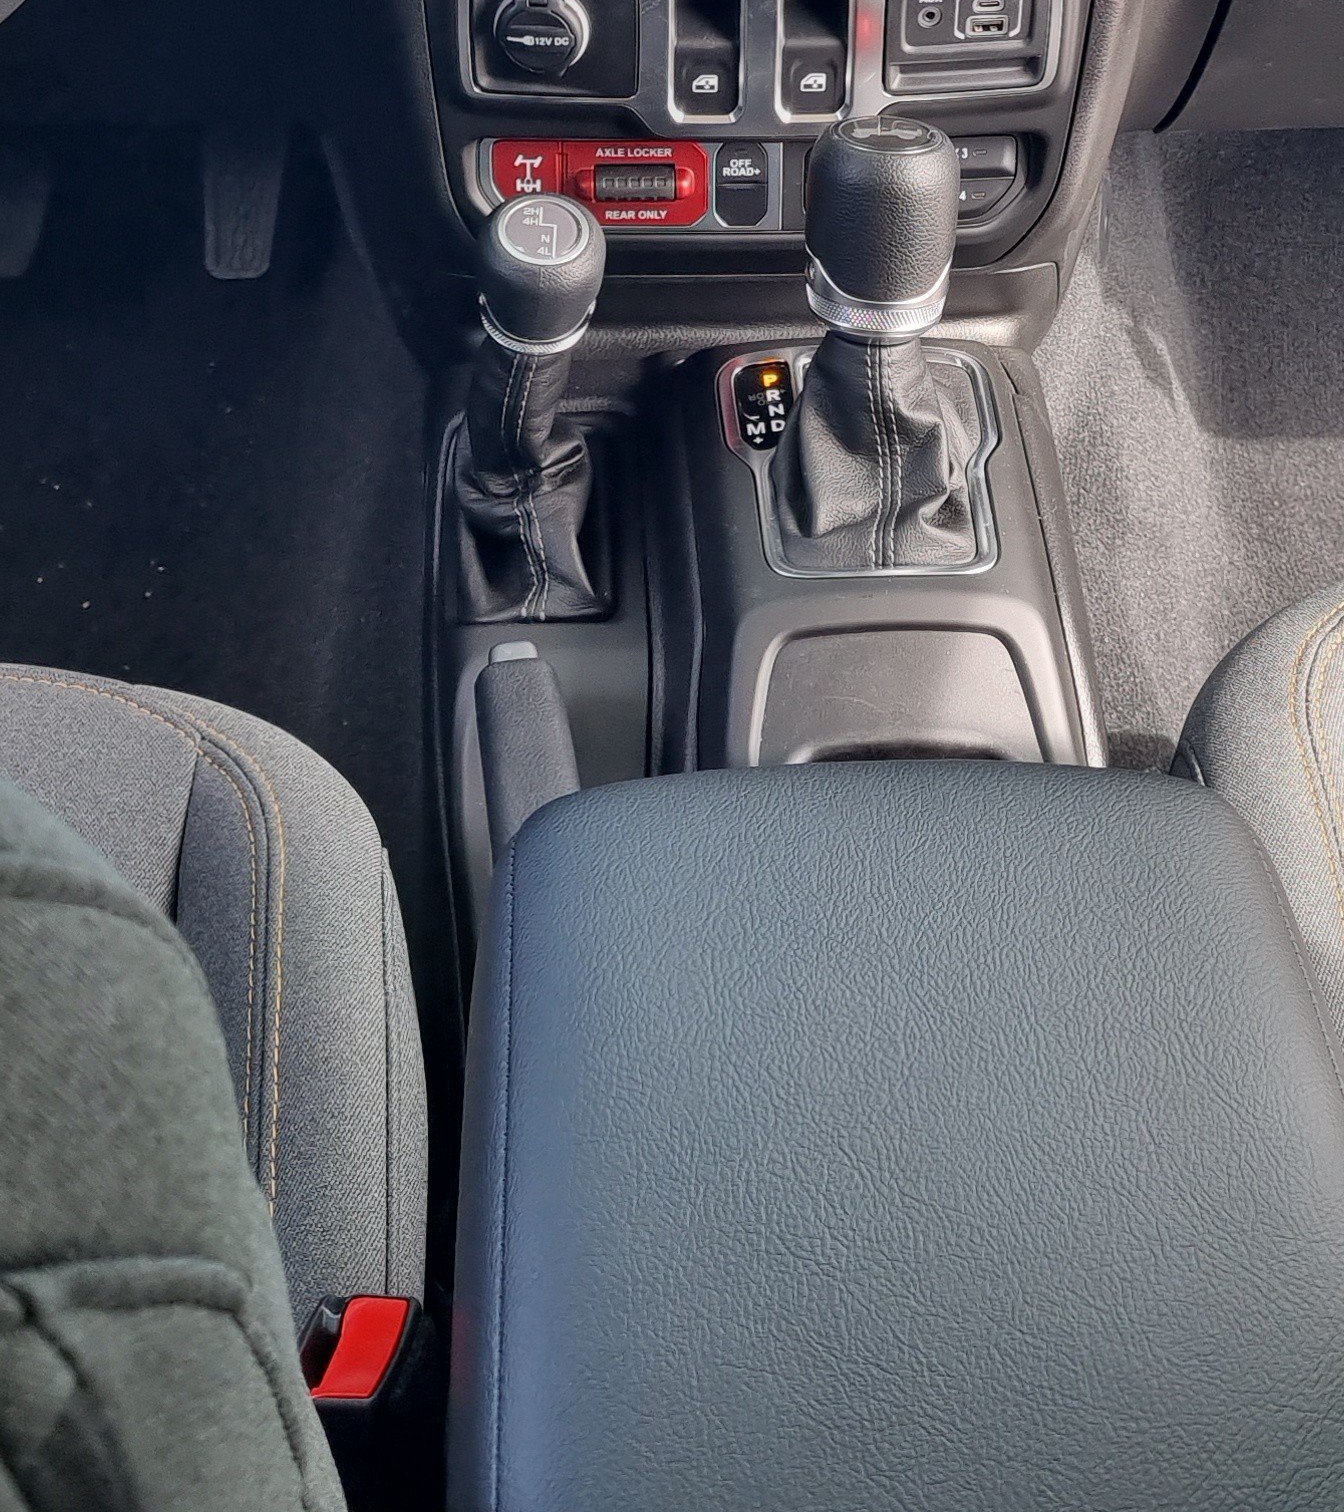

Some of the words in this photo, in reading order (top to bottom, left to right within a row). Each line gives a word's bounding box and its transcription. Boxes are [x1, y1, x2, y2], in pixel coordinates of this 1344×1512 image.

[535, 36, 552, 46] 12V
[554, 36, 570, 46] DC
[595, 147, 625, 158] AXLE
[627, 147, 673, 157] LOCKER
[729, 159, 752, 168] OFF
[722, 166, 761, 177] ROAD+
[522, 207, 539, 216] 2H
[605, 210, 636, 219] REAR
[638, 209, 668, 220] ONLY
[521, 217, 539, 226] 4H
[540, 234, 550, 243] N
[537, 245, 552, 256] 4L
[763, 374, 778, 387] P
[765, 389, 782, 402] R
[768, 403, 785, 417] N
[746, 422, 766, 436] M
[770, 420, 786, 432] D
